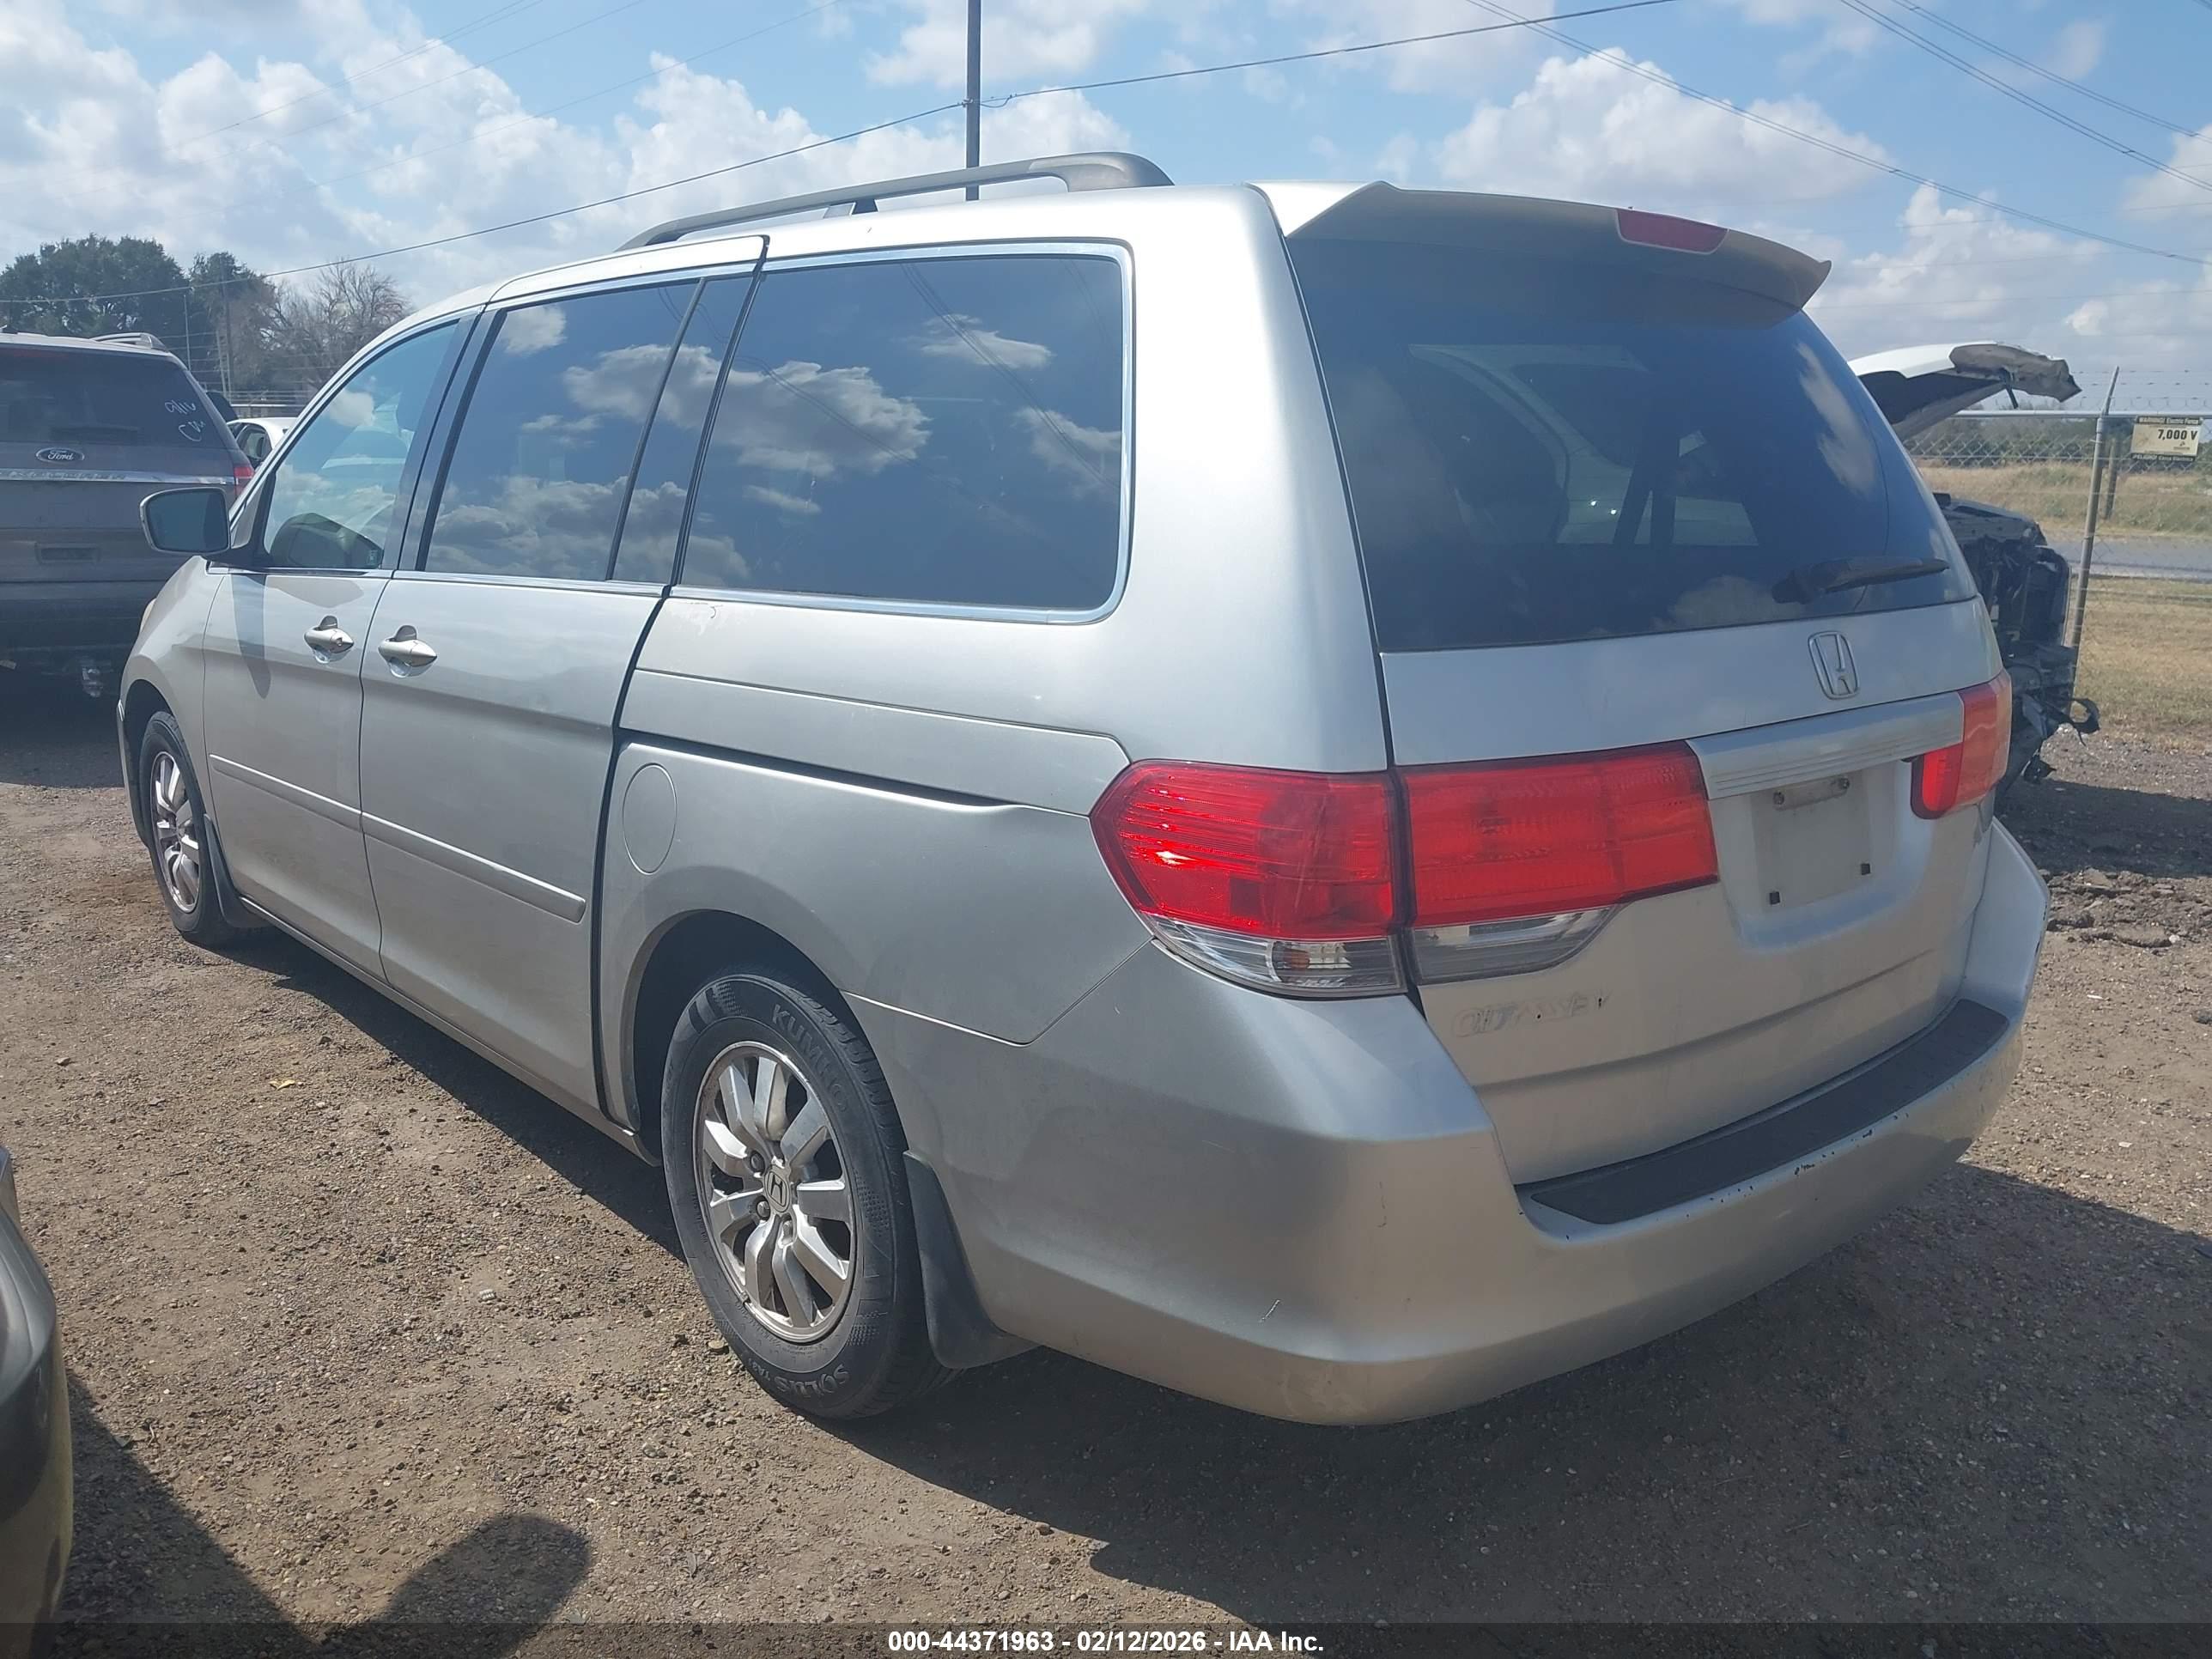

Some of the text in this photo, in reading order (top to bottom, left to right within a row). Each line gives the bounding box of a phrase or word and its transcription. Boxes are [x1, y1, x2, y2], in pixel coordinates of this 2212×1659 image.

[2158, 428, 2198, 441] 7,000 V
[771, 1003, 849, 1113] KUMHO
